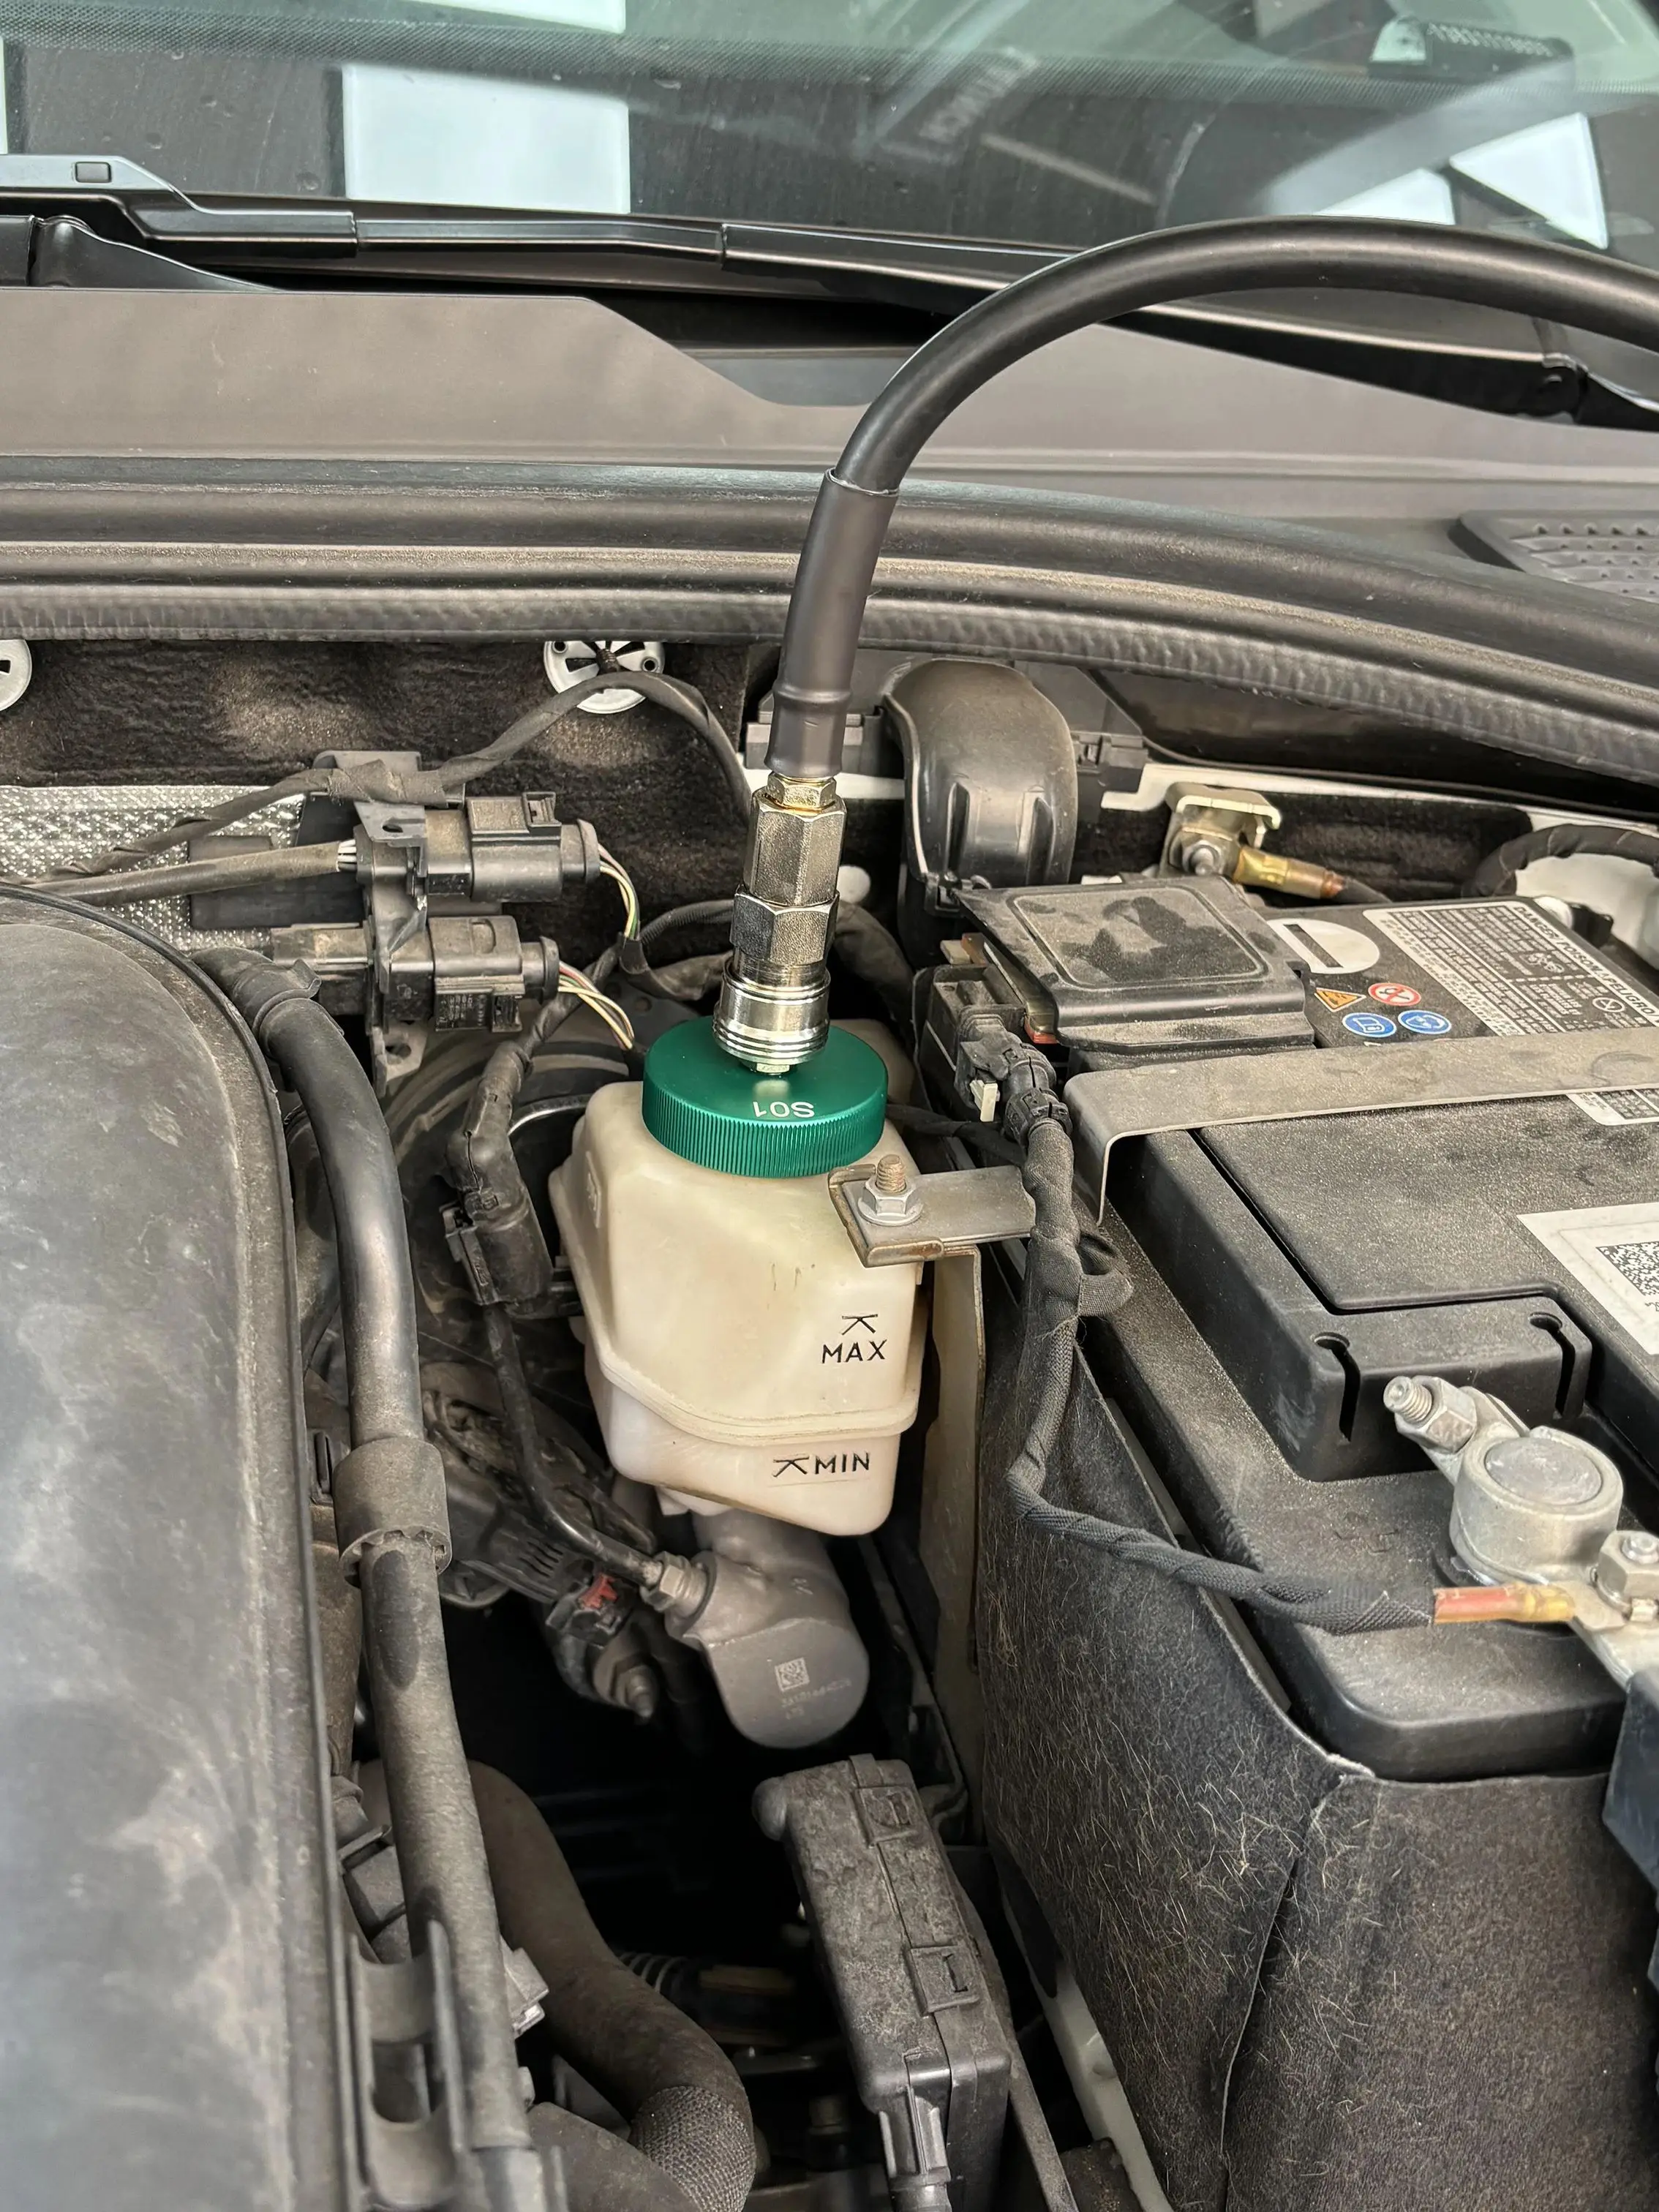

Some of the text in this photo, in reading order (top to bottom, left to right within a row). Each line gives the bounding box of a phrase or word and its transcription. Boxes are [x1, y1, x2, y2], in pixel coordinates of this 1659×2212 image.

[752, 1101, 815, 1118] S01
[821, 1339, 887, 1363] MAX
[815, 1451, 870, 1475] MIN
